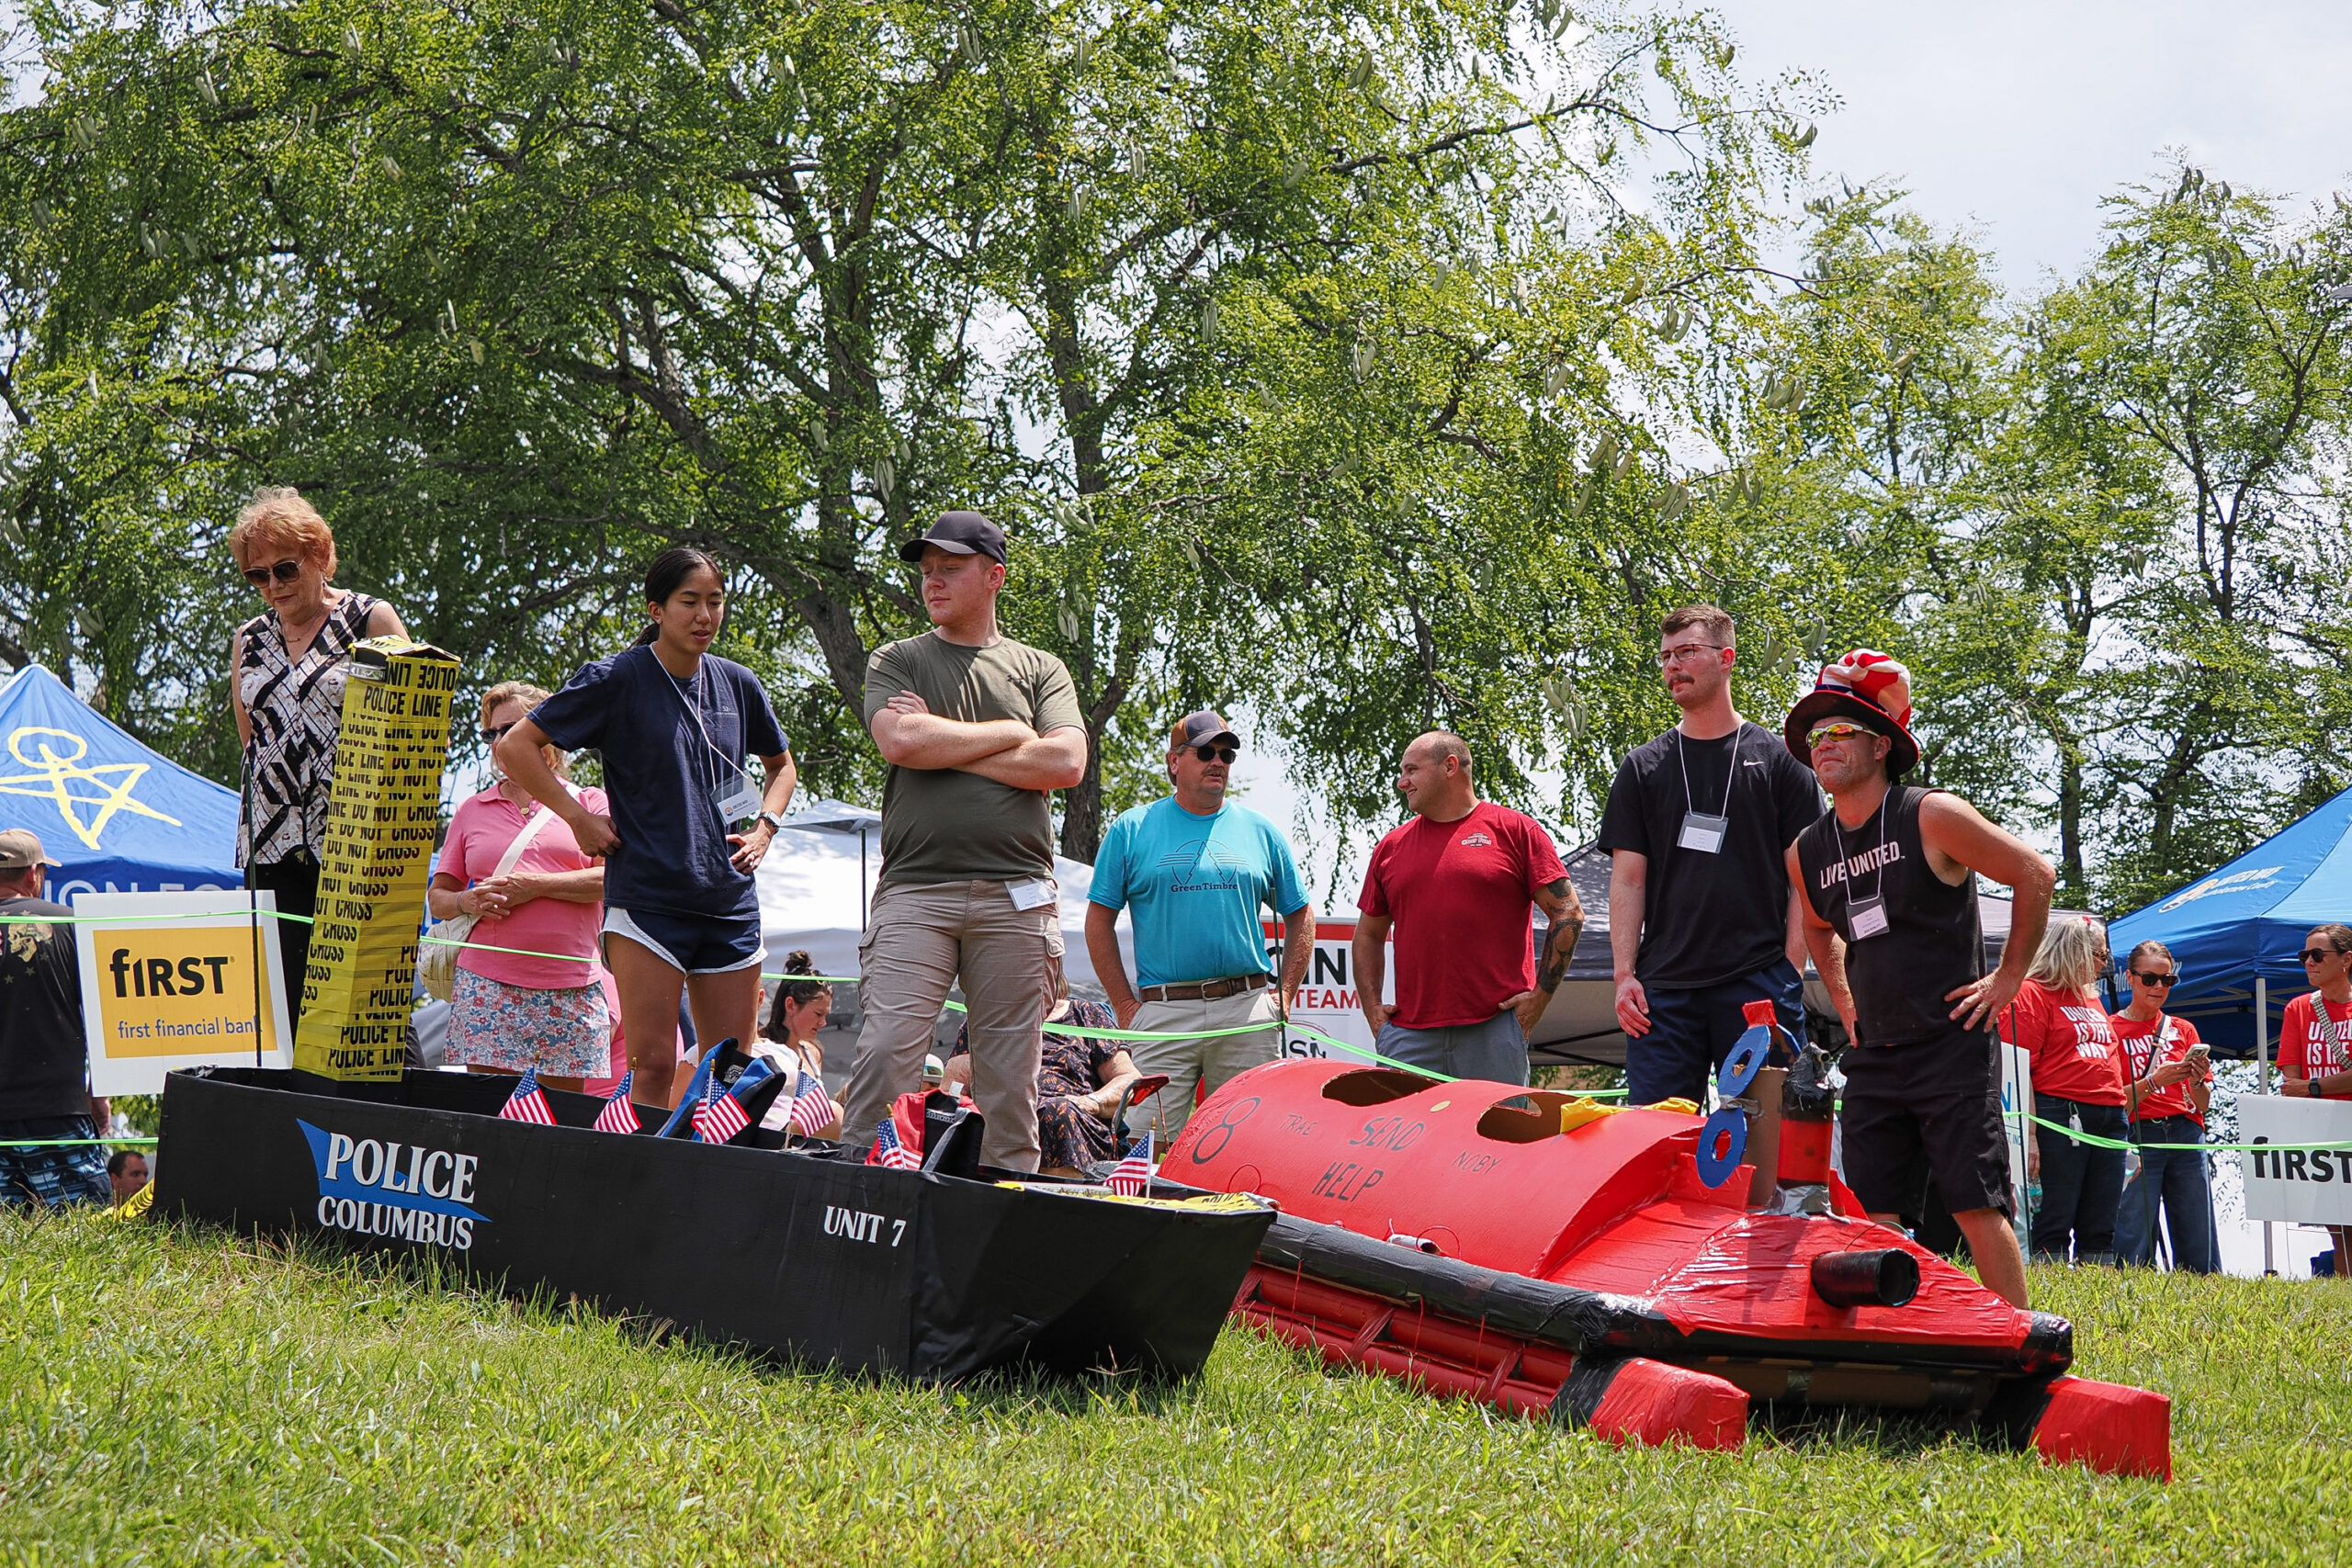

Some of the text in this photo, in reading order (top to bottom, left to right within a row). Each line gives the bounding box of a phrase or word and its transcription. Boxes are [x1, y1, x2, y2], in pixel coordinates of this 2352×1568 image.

[364, 685, 406, 716] POLICE
[413, 694, 443, 718] LINE
[1820, 840, 1901, 889] LIVE UNITED
[335, 899, 373, 922] CROSS
[1295, 988, 1362, 1010] TEAM
[118, 1021, 151, 1039] first
[154, 1017, 220, 1037] financial
[340, 1024, 389, 1045] POLICE
[2074, 1021, 2089, 1044] IS
[327, 1048, 375, 1069] POLICE
[2075, 1041, 2109, 1059] WAY
[2307, 1043, 2323, 1066] IS
[1192, 1097, 1243, 1165] 8
[1284, 1114, 1317, 1136] TRAE
[1349, 1116, 1426, 1152] SEND
[323, 1132, 478, 1203] POLICE
[1451, 1151, 1503, 1176] NOBY
[1311, 1161, 1385, 1203] HELP
[317, 1195, 474, 1250] COLUMBUS
[823, 1205, 907, 1247] UNIT 7
